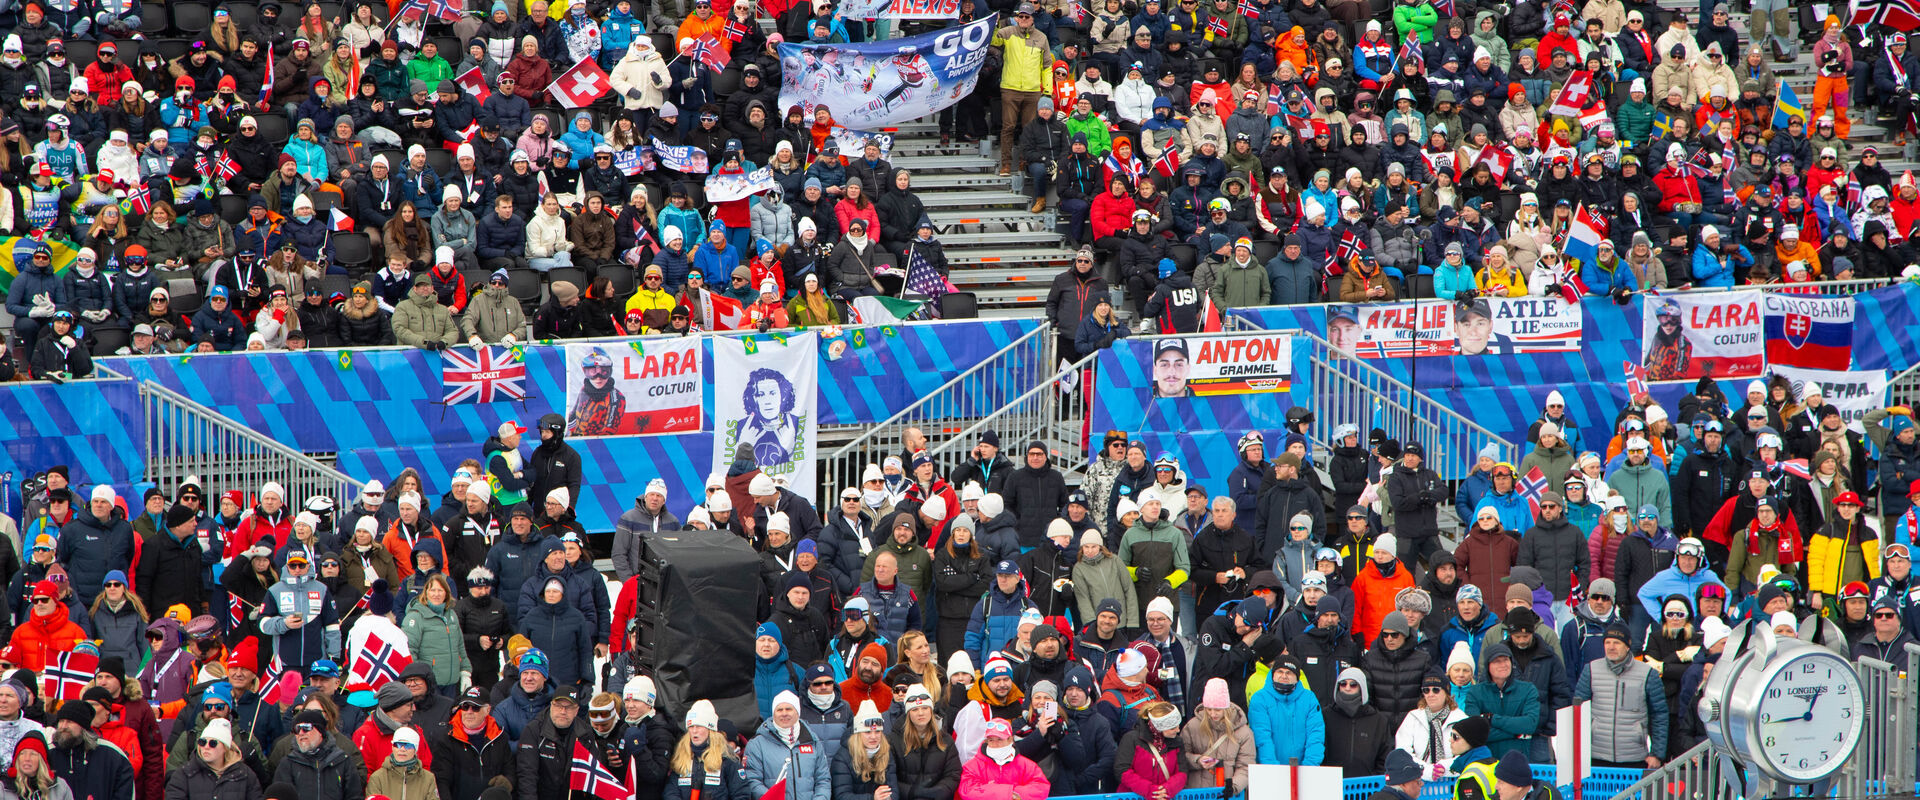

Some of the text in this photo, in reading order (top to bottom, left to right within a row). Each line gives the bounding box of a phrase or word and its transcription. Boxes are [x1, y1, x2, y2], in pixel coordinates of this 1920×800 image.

[888, 0, 960, 14] ALEXIS
[933, 20, 990, 57] GO
[944, 43, 989, 71] ALEXIS
[49, 152, 73, 166] DNB
[615, 149, 637, 162] XIS
[749, 167, 767, 180] GO
[1172, 288, 1197, 306] USA
[1366, 304, 1447, 329] ATLE LIE
[1496, 301, 1558, 319] ATLE
[1690, 301, 1760, 329] LARA
[1511, 320, 1579, 334] LIE MCGRATH
[1713, 332, 1760, 346] COLTUR
[1196, 338, 1281, 364] ANTON
[623, 348, 698, 380] LARA
[1219, 364, 1278, 376] GRAMMEL
[472, 371, 500, 381] ROCKET
[648, 381, 697, 397] COLTURI
[1815, 381, 1875, 399] ETRA.
[793, 409, 807, 461] BRAZIL
[723, 419, 738, 465] LUCAS
[764, 461, 795, 477] CLUB
[1802, 663, 1815, 674] 12
[1827, 669, 1832, 679] 1
[1784, 671, 1793, 681] 11
[1769, 688, 1781, 699] 10
[1787, 685, 1828, 695] LONGINES
[1837, 684, 1847, 695] 2
[1761, 712, 1771, 724] 9
[1841, 707, 1851, 719] 3
[1765, 736, 1776, 747] 8
[1833, 732, 1844, 742] 4
[1780, 753, 1789, 764] 7
[1819, 751, 1829, 762] 5
[1798, 758, 1809, 769] 6
